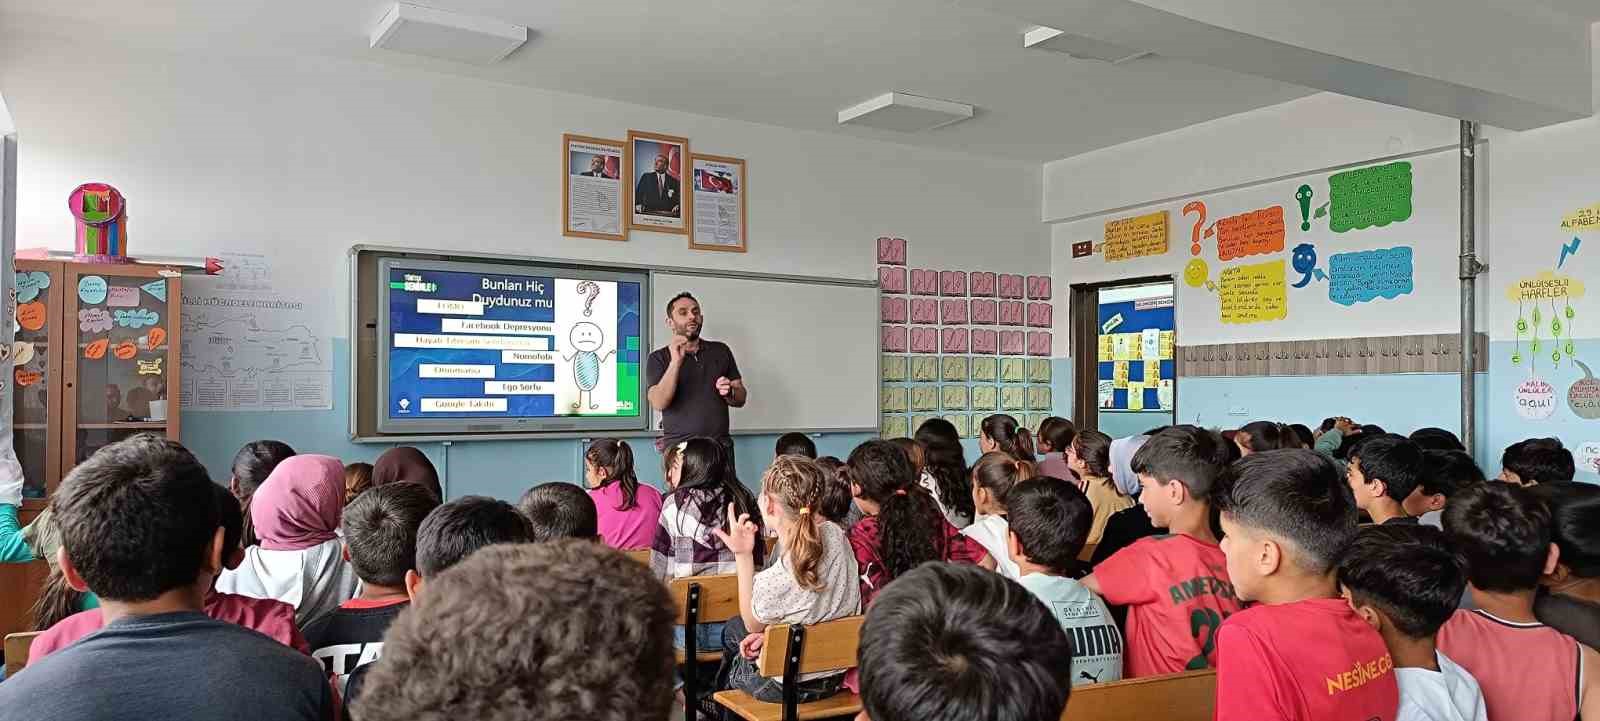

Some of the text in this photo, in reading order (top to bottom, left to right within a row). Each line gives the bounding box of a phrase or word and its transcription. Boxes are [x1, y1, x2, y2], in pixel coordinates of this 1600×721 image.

[482, 278, 545, 294] Bunları Hiç
[1521, 287, 1567, 299] HARFLER
[472, 293, 553, 308] Duydunuz mu
[461, 321, 552, 333] Facebook Depresyonu
[1066, 625, 1121, 657] UMA
